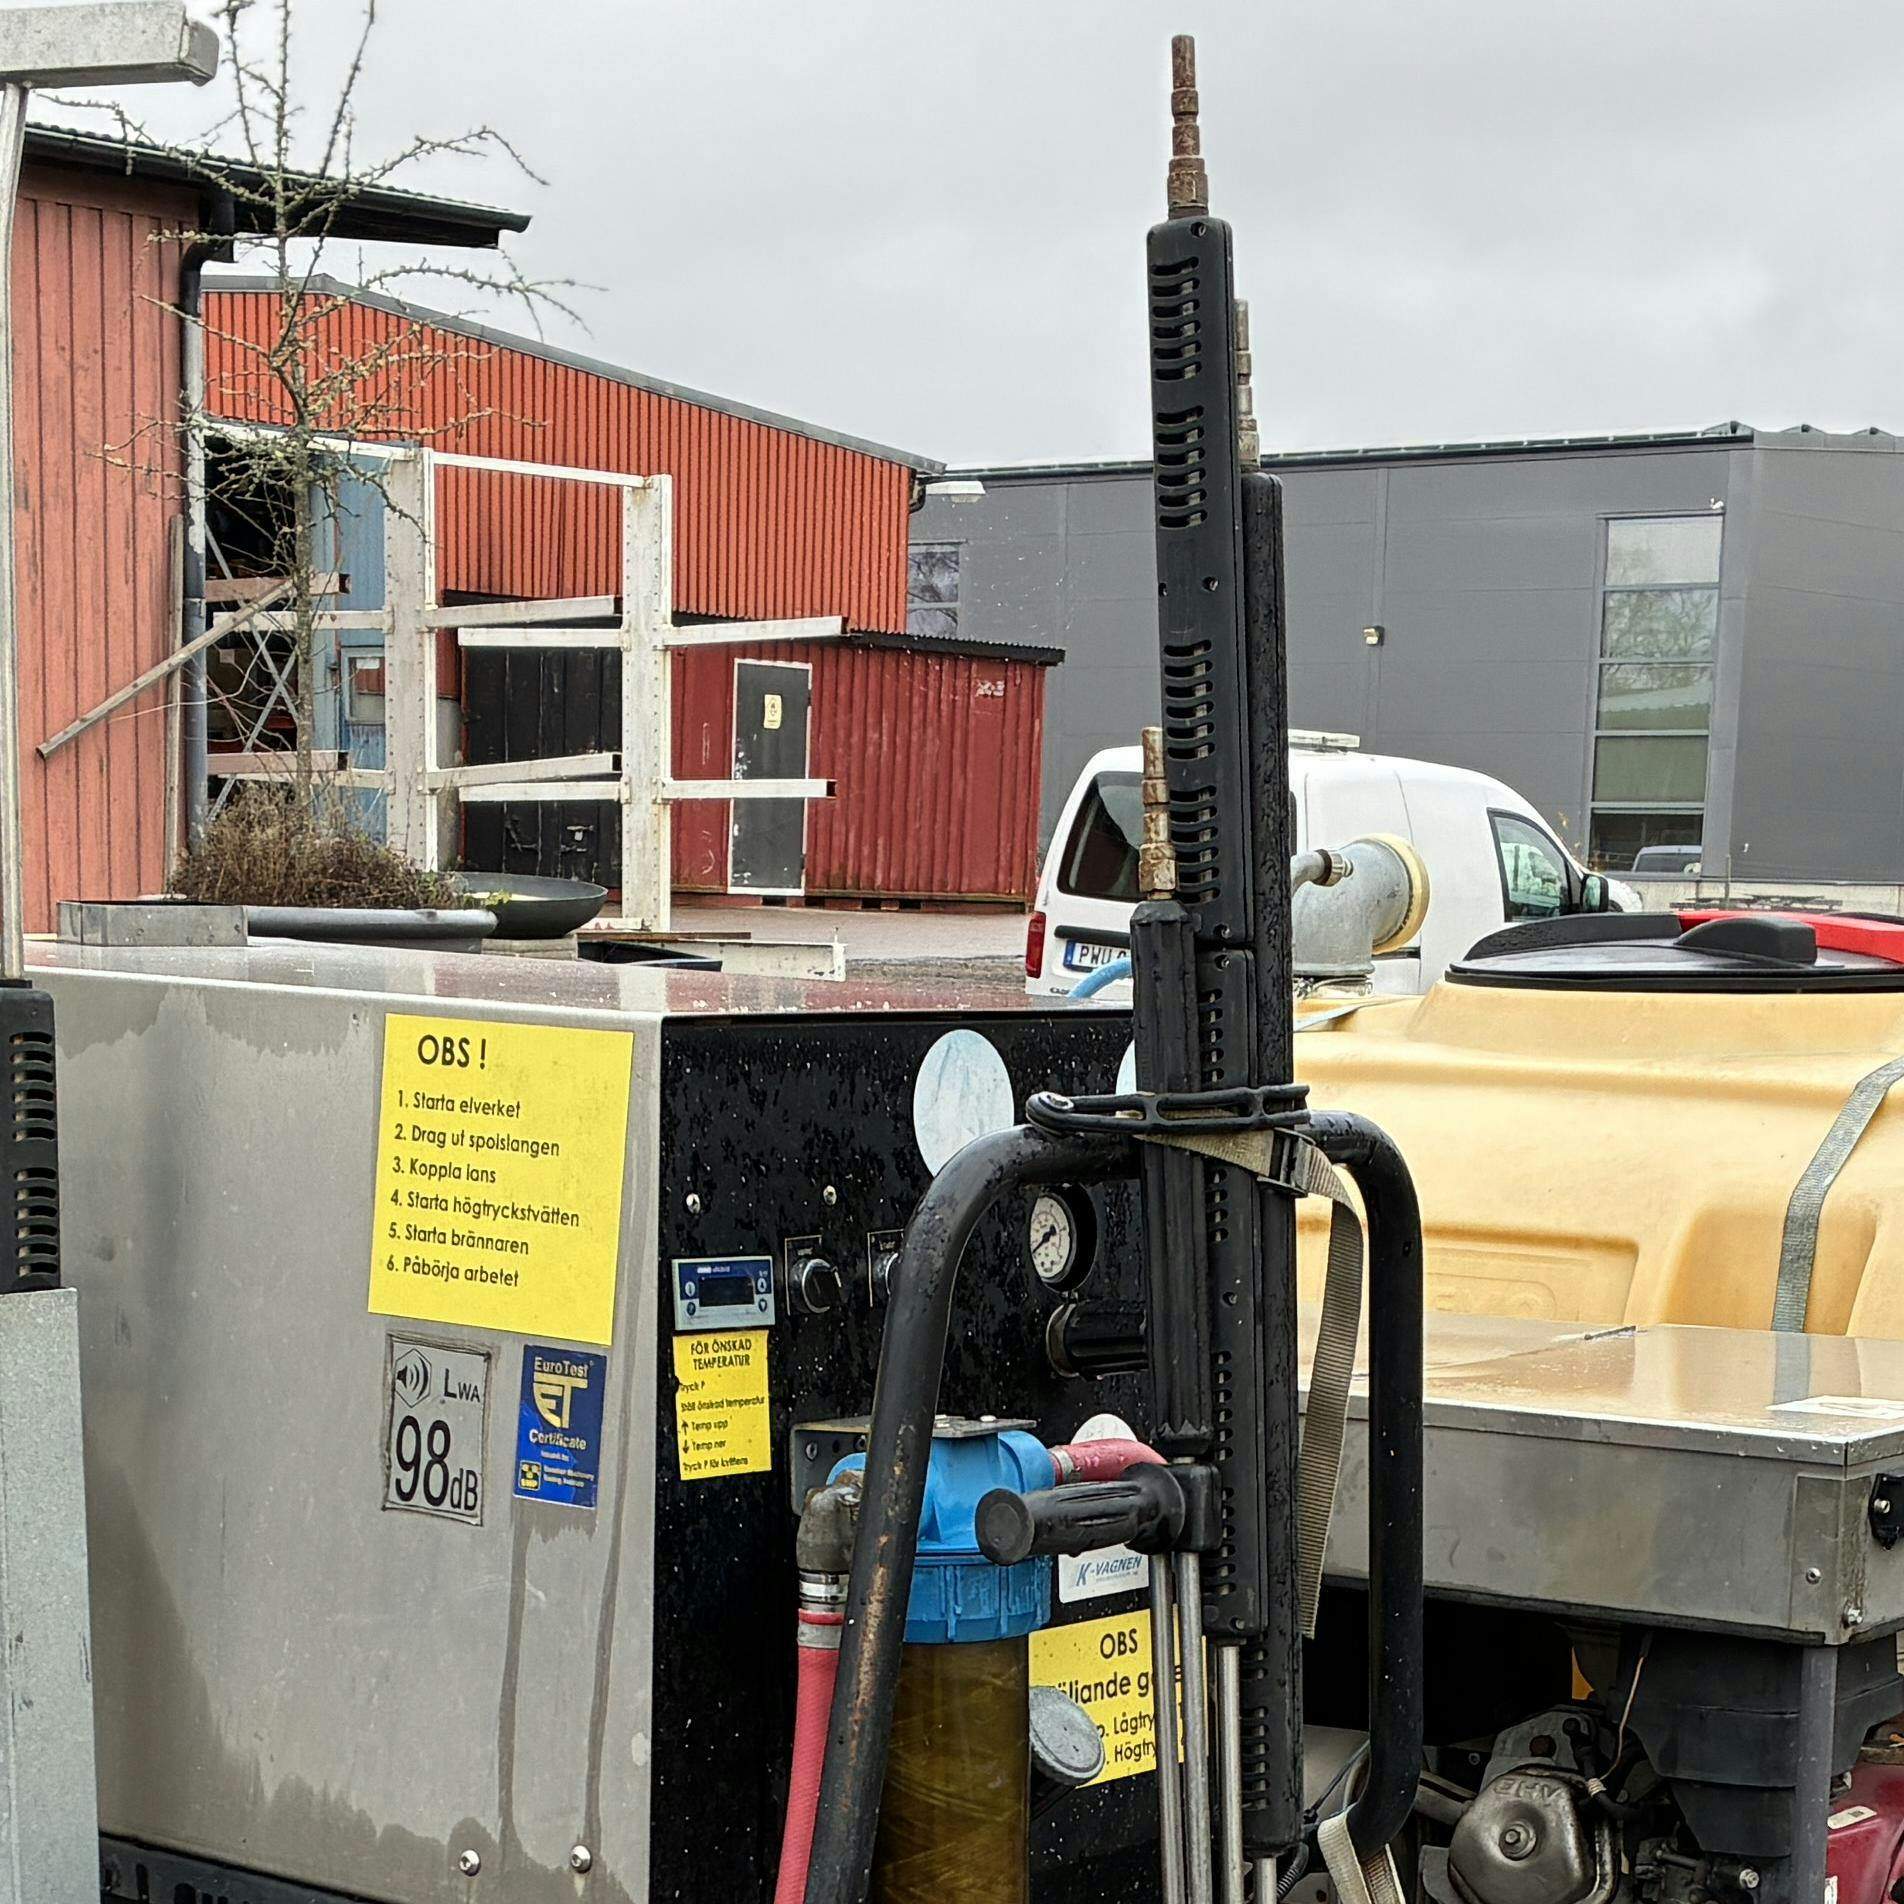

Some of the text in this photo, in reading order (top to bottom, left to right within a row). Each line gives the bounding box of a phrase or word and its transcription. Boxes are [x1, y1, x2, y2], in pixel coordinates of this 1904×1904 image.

[418, 1034, 487, 1070] OBS !
[398, 1090, 521, 1119] 1. Starta elverket
[394, 1123, 560, 1158] 2. Drag ut spolslangen
[392, 1156, 496, 1184] 3. Koppla lans
[390, 1189, 580, 1228] 4. Starta högtryckstvätten
[388, 1222, 529, 1255] 5. Starta brännaren
[386, 1254, 519, 1287] 6. Påbörja arbetet
[691, 1339, 752, 1356] FÖR ÖNSKAD
[693, 1354, 751, 1370] TEMPERATUR
[534, 1357, 589, 1378] EuroTest
[529, 1428, 587, 1451] Certificate
[1076, 1556, 1143, 1587] K-VAGNEN
[1099, 1628, 1138, 1660] OBS
[1057, 1671, 1131, 1704] ljande
[1113, 1711, 1155, 1735] Lågtry
[1114, 1738, 1156, 1763] Högtry
